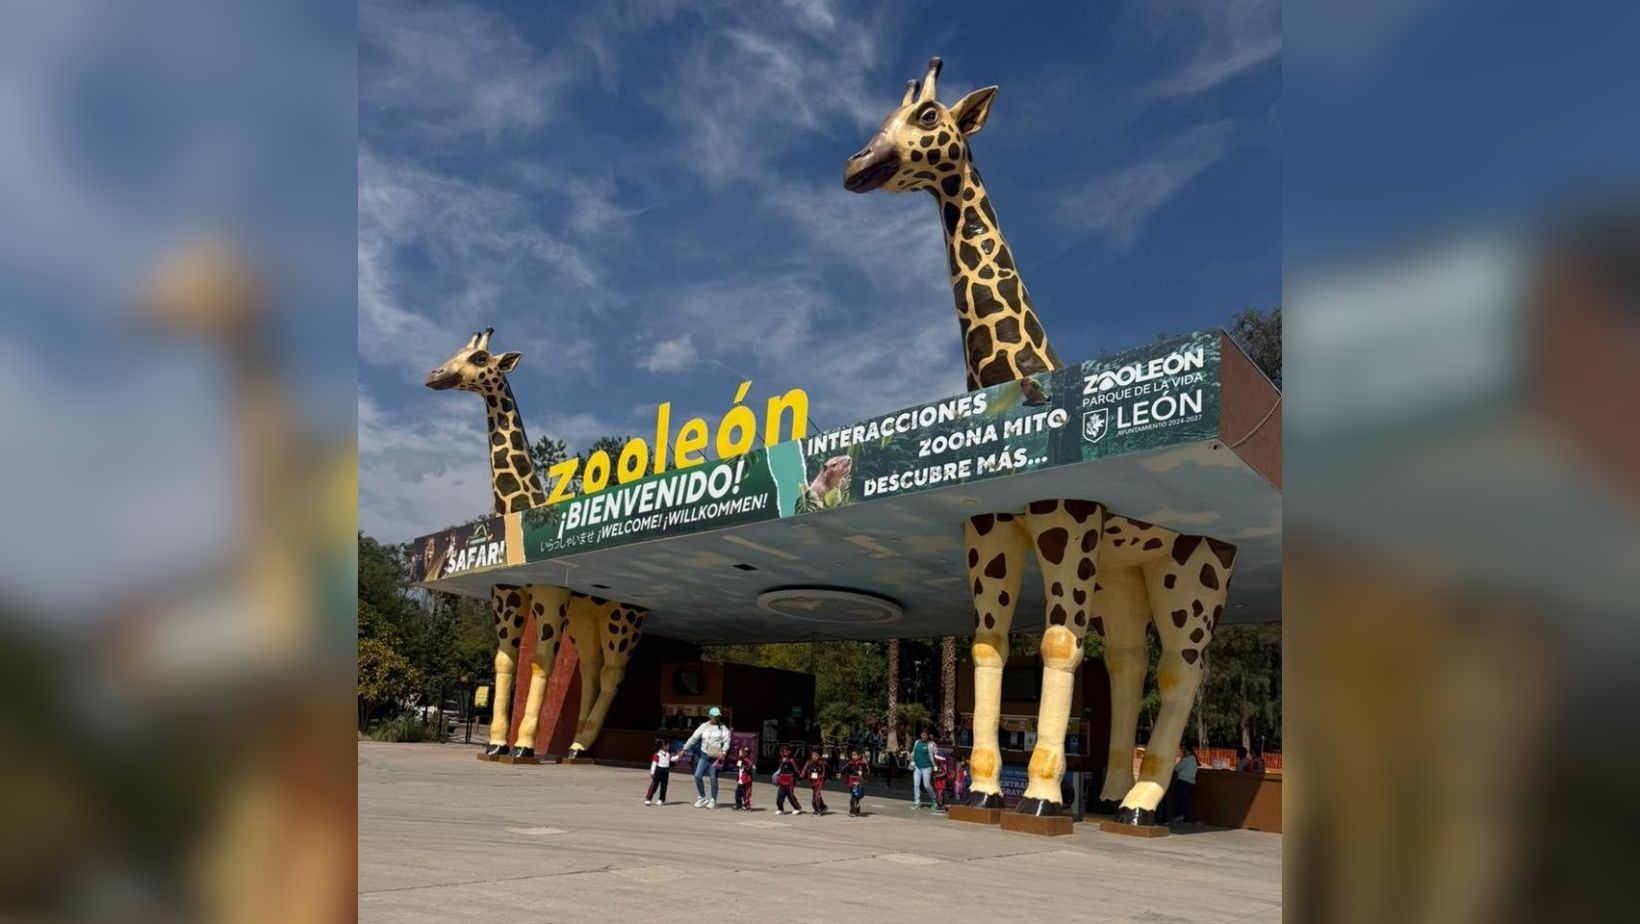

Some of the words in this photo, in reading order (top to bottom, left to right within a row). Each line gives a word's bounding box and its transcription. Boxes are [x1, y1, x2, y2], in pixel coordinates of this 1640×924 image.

[1082, 347, 1204, 396] ZOOLEÓN
[1082, 388, 1133, 408] PARQUE
[1134, 383, 1152, 397] DE
[1153, 379, 1170, 393] LA
[1171, 372, 1204, 388] VIDA
[807, 392, 988, 457] INTERACCIONES
[918, 424, 998, 457] ZOONA
[1003, 408, 1068, 439] MITO
[1116, 421, 1168, 437] AYUNTAMIENTO
[1117, 389, 1203, 429] LEÓN
[546, 379, 809, 505] zooleón
[863, 459, 972, 497] DESCUBRE
[976, 445, 1048, 475] MÁS...
[557, 459, 745, 540] ¡BIENVENIDO!
[597, 512, 663, 544] ¡WELCOME!
[663, 492, 769, 531] ¡WILLKOMMEN!
